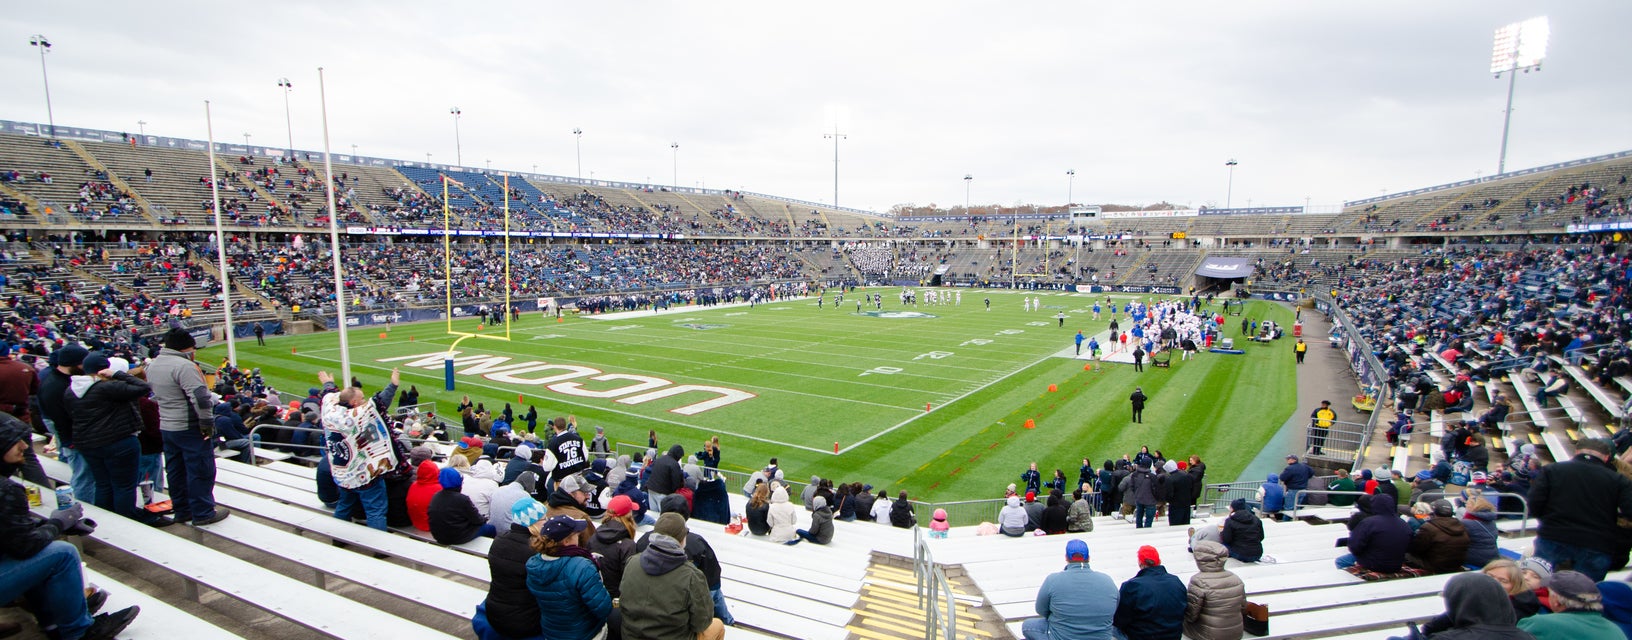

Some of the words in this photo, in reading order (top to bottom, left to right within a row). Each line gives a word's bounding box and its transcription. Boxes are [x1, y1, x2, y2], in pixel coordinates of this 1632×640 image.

[375, 350, 758, 415] UCONN
[558, 440, 580, 453] STAPLES
[563, 446, 578, 461] 76
[558, 456, 584, 470] FOOTBALL
